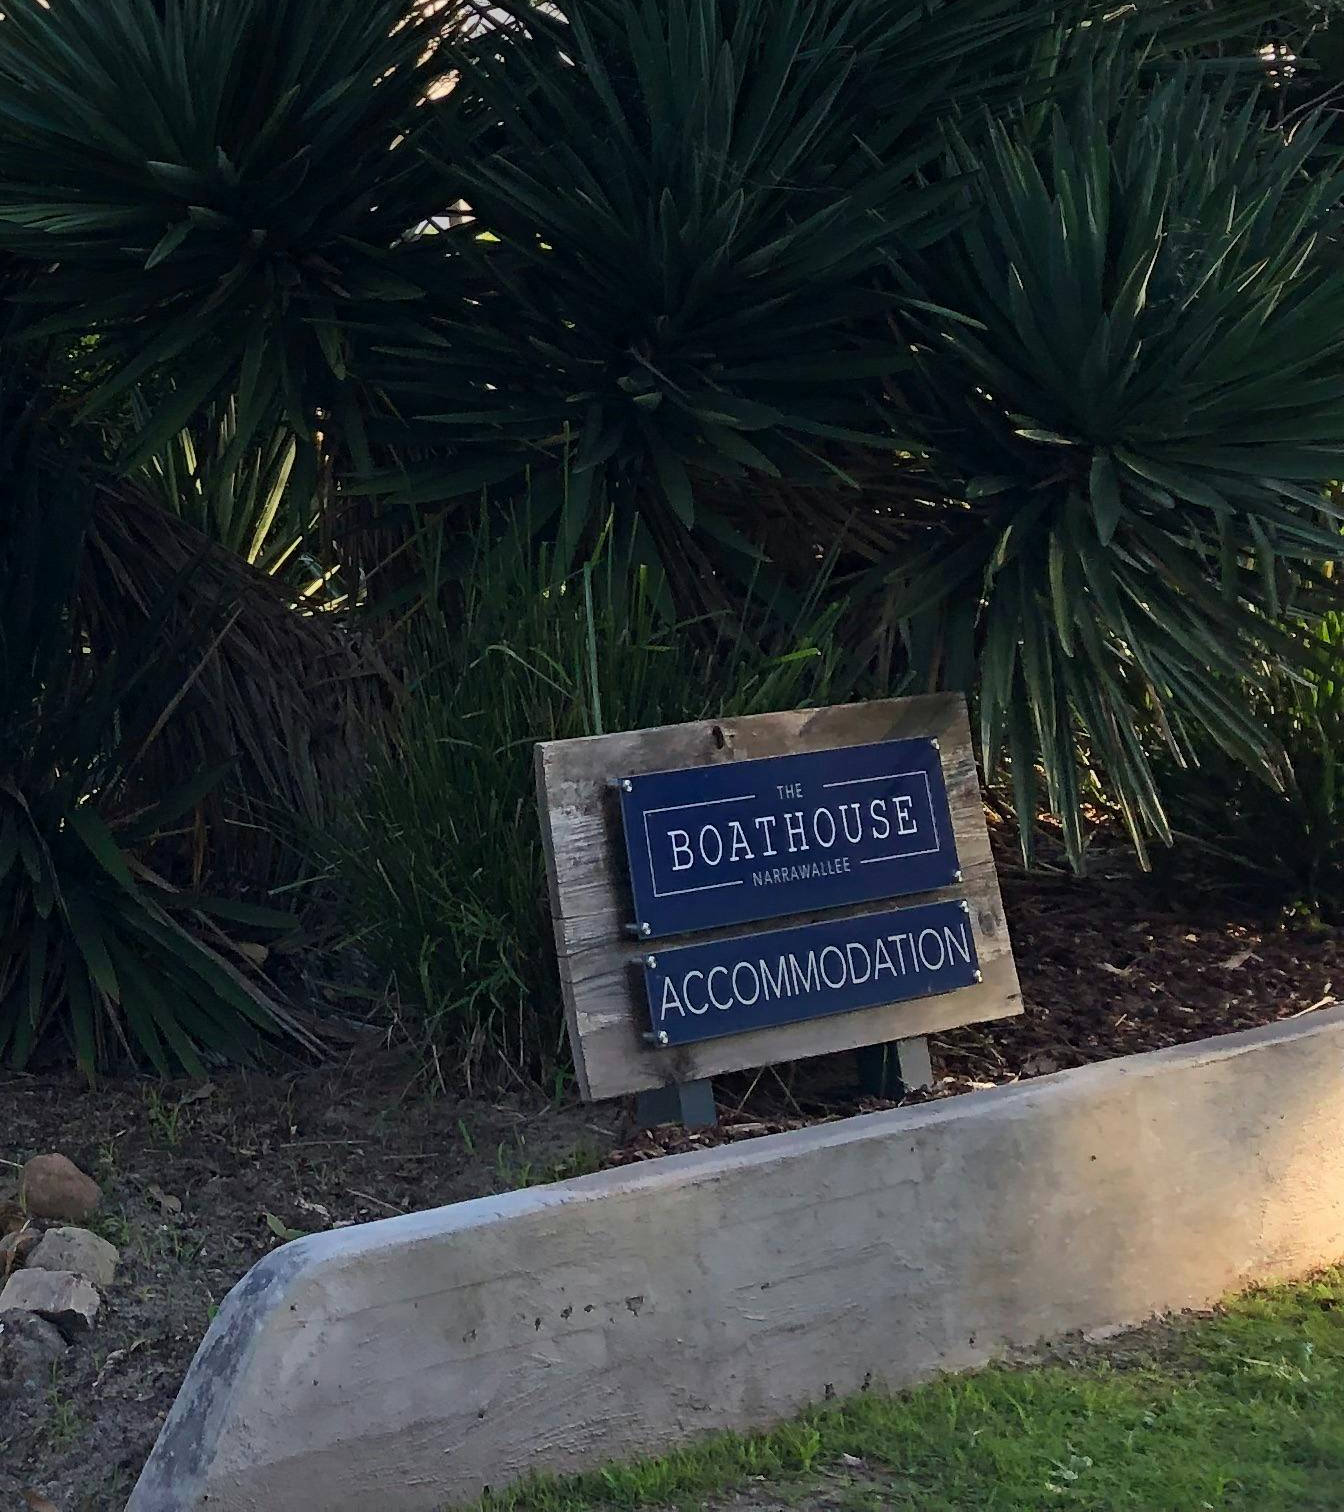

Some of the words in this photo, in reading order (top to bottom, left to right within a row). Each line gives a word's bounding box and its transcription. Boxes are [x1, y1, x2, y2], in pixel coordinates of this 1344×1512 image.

[776, 783, 804, 800] THE
[667, 796, 917, 871] BOATHOUSE
[752, 857, 851, 887] NARRAWALLEE
[660, 924, 971, 1020] ACCOMMODATION
